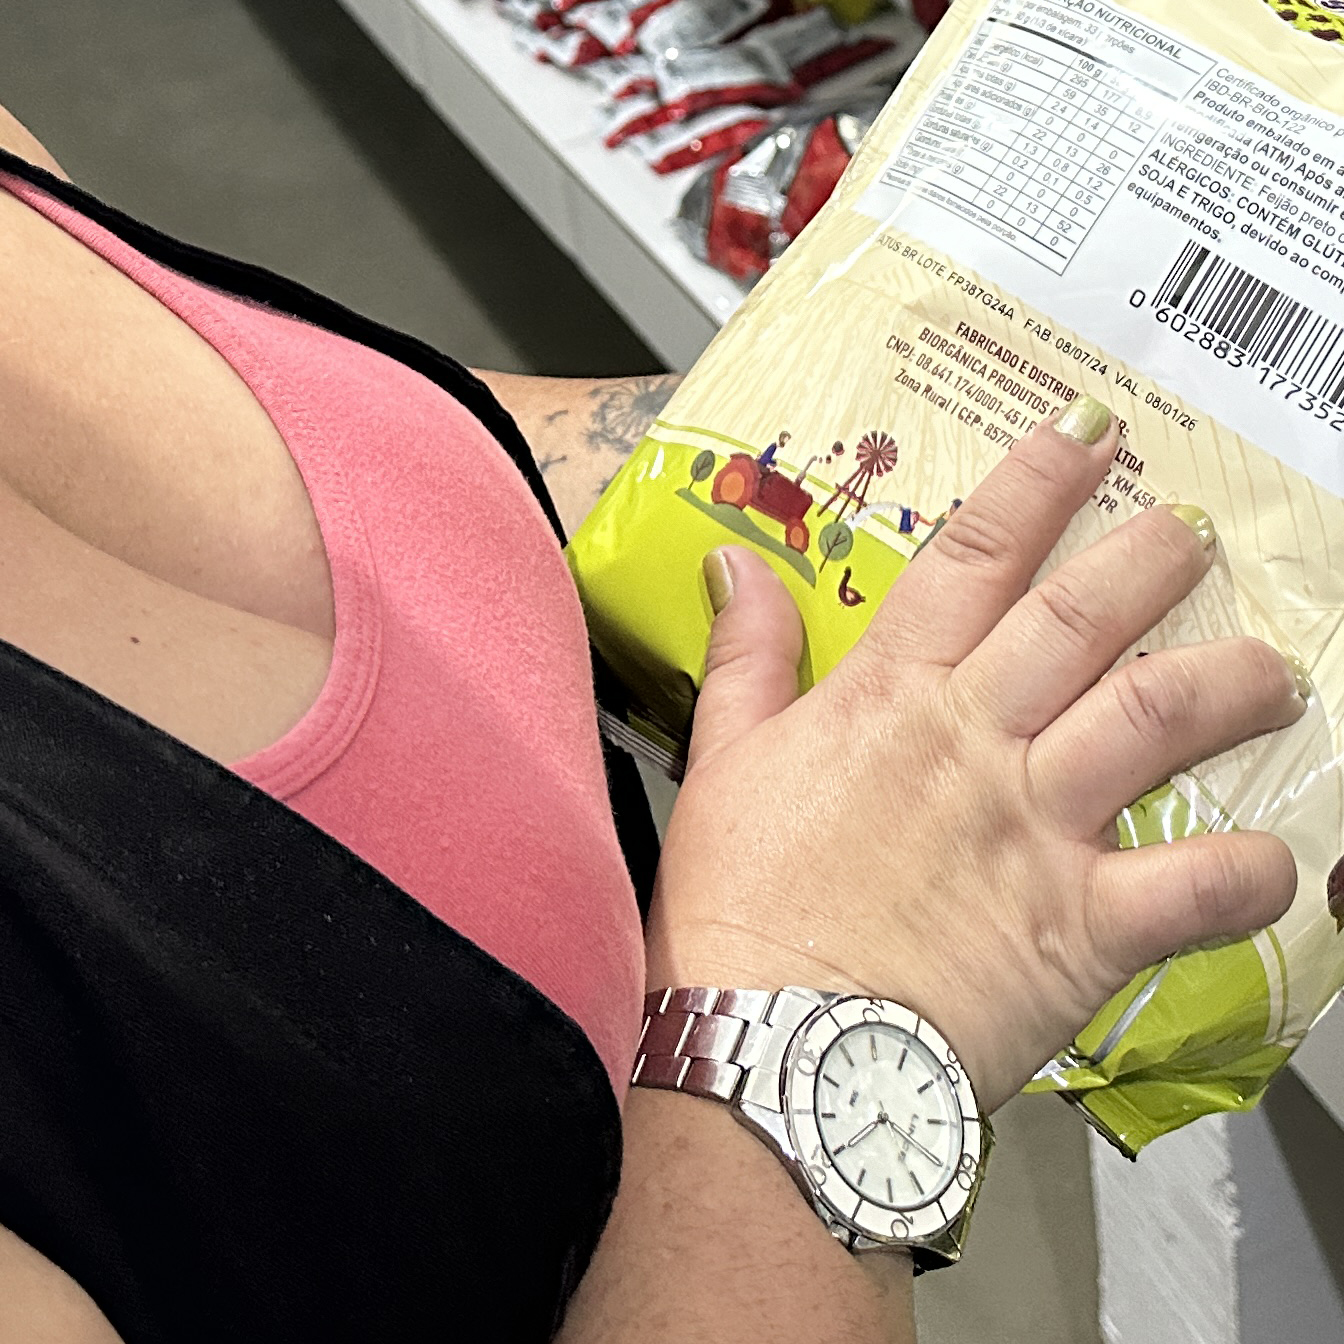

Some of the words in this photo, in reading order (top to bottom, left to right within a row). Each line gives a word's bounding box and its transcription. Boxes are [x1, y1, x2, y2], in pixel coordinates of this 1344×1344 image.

[1094, 7, 1182, 60] NUTRICIONAL
[1069, 73, 1090, 89] 295
[1102, 89, 1123, 104] 177
[1078, 58, 1095, 73] 100
[1062, 88, 1077, 100] 59
[1093, 103, 1109, 117] 35
[1128, 121, 1142, 134] 12
[1205, 79, 1305, 134] IBD-BR-BIO-122
[1217, 68, 1280, 107] Certificado
[1281, 106, 1335, 131] orgânico
[1031, 128, 1048, 142] 22
[1065, 145, 1079, 158] 13
[1095, 162, 1112, 176] 26
[1044, 115, 1055, 126] 0
[1076, 132, 1086, 143] 0
[1108, 149, 1119, 160] 0
[1193, 91, 1244, 122] Produto
[1246, 120, 1310, 156] embalado
[1313, 154, 1335, 170] em
[1160, 134, 1255, 190] INGREDIENTE:
[1258, 185, 1298, 215] Feijão
[1298, 211, 1335, 236] preto
[1251, 161, 1270, 176] ou
[1272, 173, 1339, 213] consumir
[1253, 140, 1294, 170] (ATM)
[1294, 163, 1333, 189] Após
[992, 184, 1009, 198] 22
[1025, 201, 1039, 215] 13
[1056, 219, 1072, 234] 52
[1005, 171, 1015, 182] 0
[1036, 188, 1046, 199] 0
[1069, 206, 1079, 218] 0
[1128, 183, 1221, 242] equipamentos.
[1139, 164, 1174, 192] SOJA
[1177, 185, 1190, 198] E
[1191, 192, 1235, 229] TRIGO,
[1241, 223, 1287, 255] devido
[1290, 253, 1309, 267] ao
[1149, 149, 1234, 202] ALÉRGICOS:
[1237, 197, 1301, 239] CONTÉM
[986, 199, 996, 209] 0
[1016, 216, 1027, 227] 0
[1049, 235, 1060, 247] 0
[901, 246, 918, 261] BR
[947, 272, 1013, 320] FP387G24A
[1055, 338, 1108, 375] 08/07/24
[1145, 392, 1197, 431] 08/01/26
[955, 322, 1019, 368] FABRICADO
[1019, 360, 1029, 374] E
[1130, 290, 1145, 308] 0
[1156, 308, 1246, 367] 602883
[886, 335, 914, 361] CNPJ:
[916, 353, 1021, 424] 08.641.174/0001-45
[1112, 475, 1135, 496] KM
[1132, 489, 1156, 509] 458
[918, 327, 987, 378] BIORGÂNICA
[987, 369, 1049, 414] PRODUTOS
[1115, 447, 1144, 476] LTDA
[895, 368, 921, 393] Zona
[921, 384, 952, 411] Rural
[958, 407, 983, 427] CEP:
[1098, 494, 1118, 513] PR
